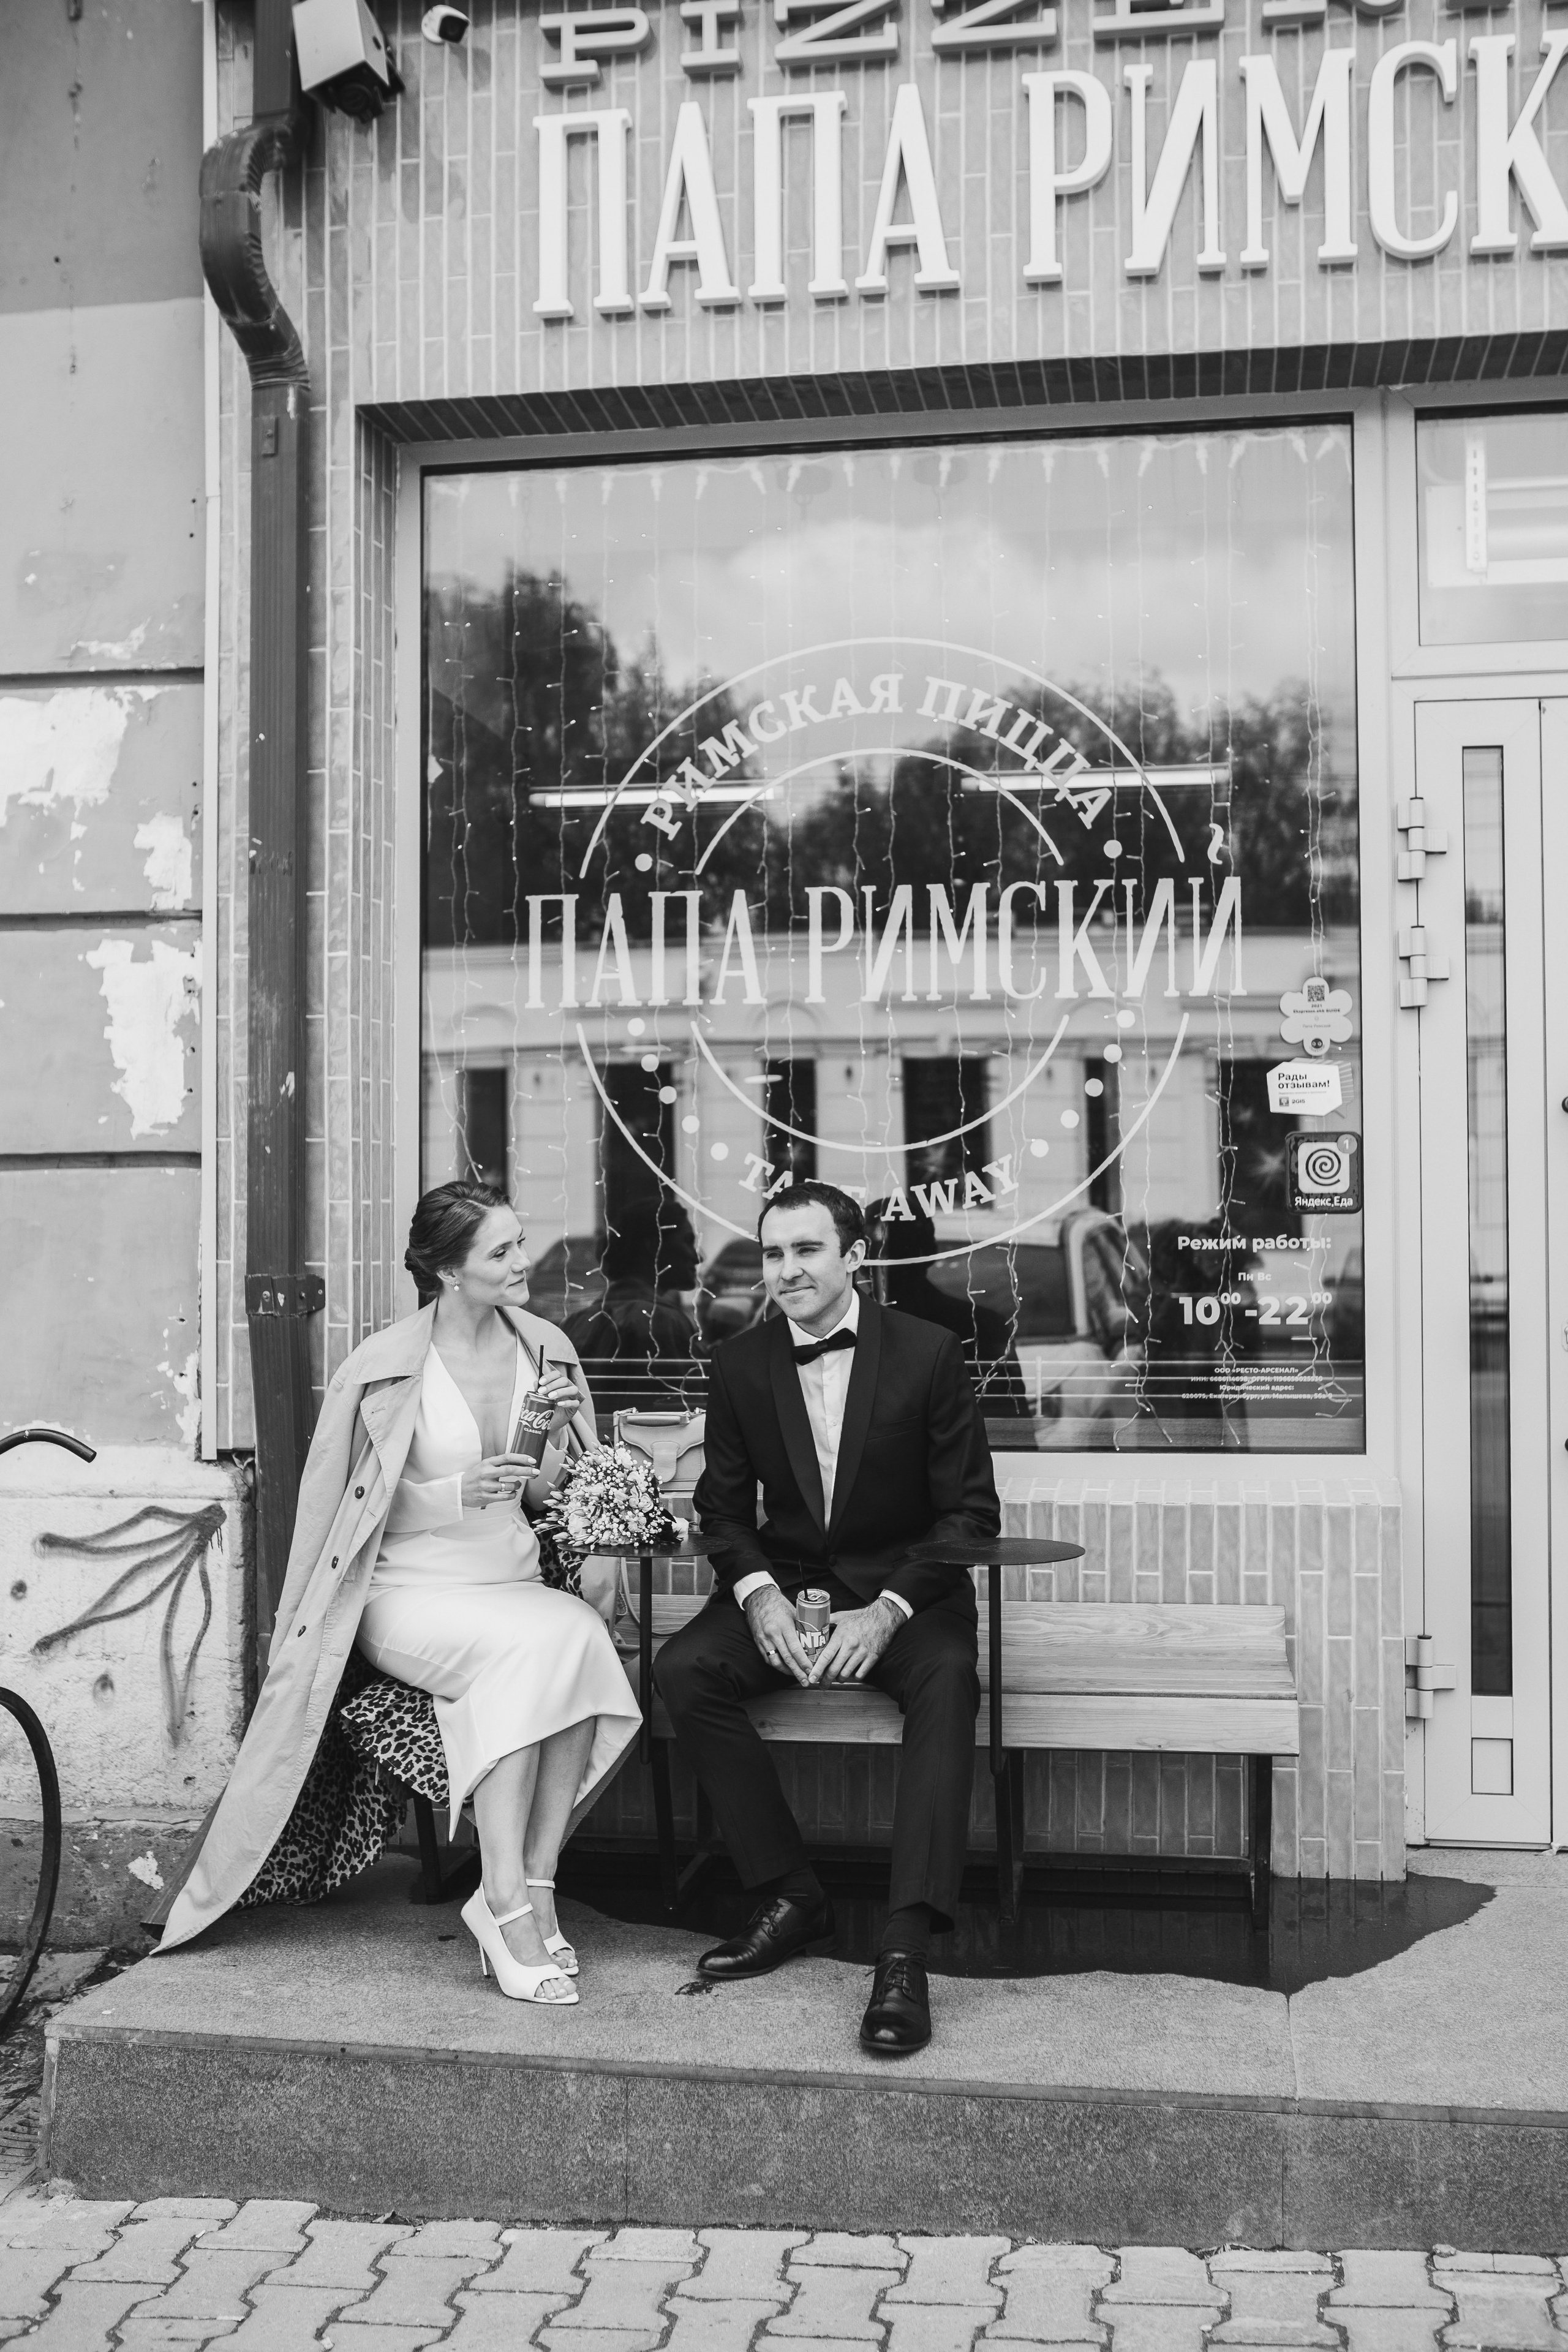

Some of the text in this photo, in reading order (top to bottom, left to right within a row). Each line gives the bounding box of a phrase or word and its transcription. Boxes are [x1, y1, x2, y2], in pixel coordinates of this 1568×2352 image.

[532, 28, 1568, 319] ПАПА РИМСК
[640, 673, 1113, 840] РИМСКАЯ ПИЦЦА
[525, 823, 1248, 1009] ПАПА РИМСКИЙ
[1278, 1072, 1308, 1081] Рады
[1278, 1079, 1330, 1089] отзывам!
[880, 1153, 1019, 1221] AWAY
[1294, 1196, 1354, 1208] Яндекс.Еда
[1177, 1234, 1332, 1253] Режим работы:
[1238, 1272, 1272, 1281] Пн Вс
